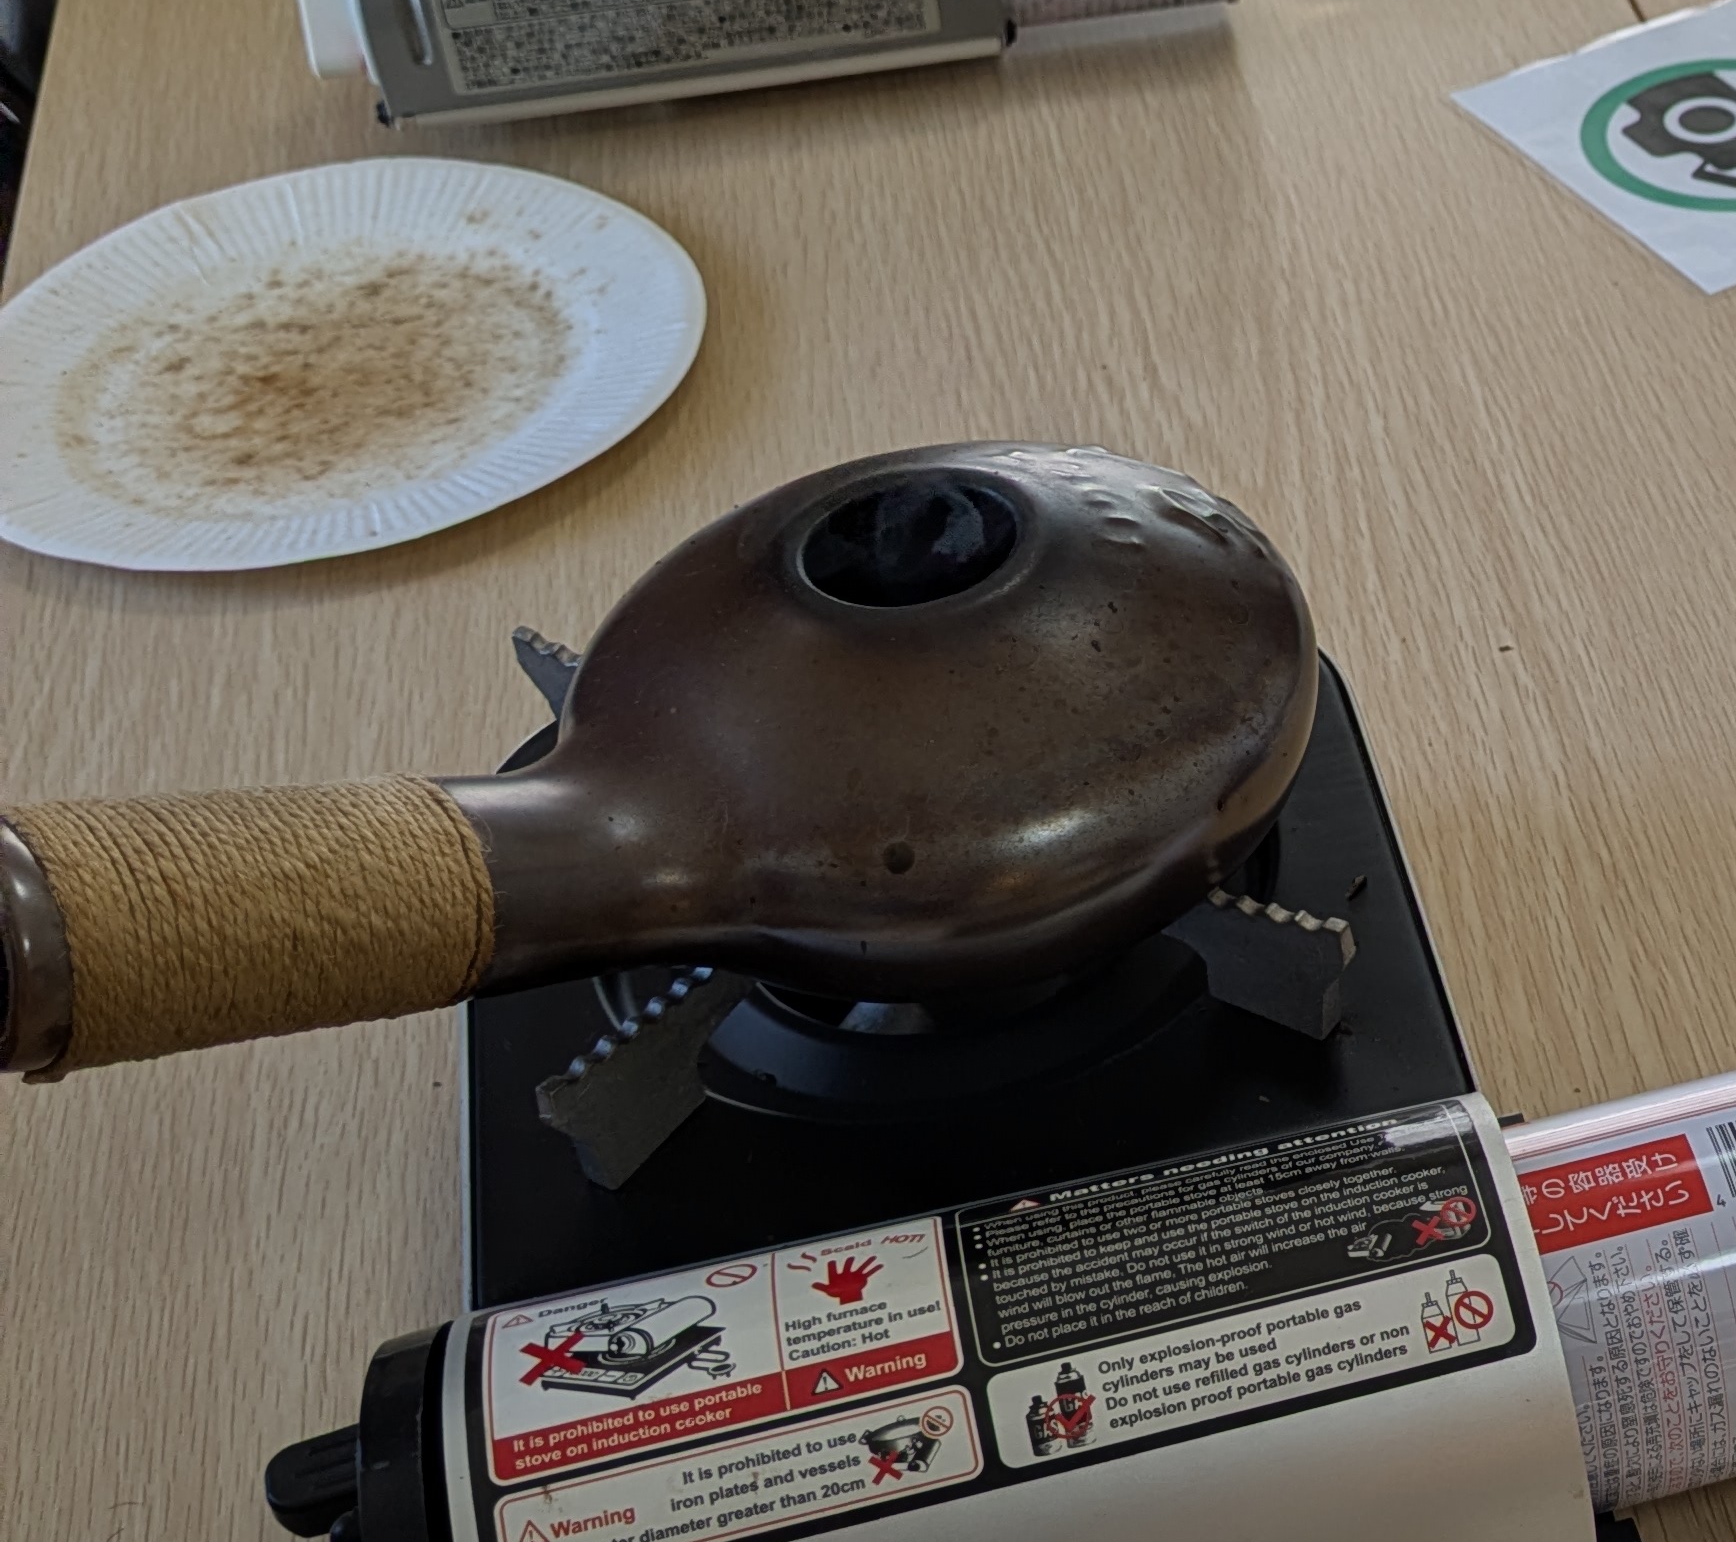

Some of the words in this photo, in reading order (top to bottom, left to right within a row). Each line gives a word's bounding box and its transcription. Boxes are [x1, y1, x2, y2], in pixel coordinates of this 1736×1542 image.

[1049, 1171, 1154, 1201] Matters
[1162, 1146, 1269, 1177] needing
[1277, 1117, 1397, 1150] attention
[1714, 1193, 1726, 1209] 4
[819, 1238, 872, 1257] Scald
[880, 1227, 926, 1250] HOT!
[995, 1283, 1048, 1304] touched
[1050, 1279, 1068, 1292] by
[1126, 1260, 1146, 1273] Do
[1148, 1254, 1170, 1267] not
[1172, 1250, 1196, 1262] use
[1198, 1246, 1207, 1256] it
[1209, 1242, 1221, 1253] in
[1222, 1232, 1264, 1251] strong
[1265, 1225, 1295, 1239] wind
[1298, 1222, 1312, 1232] or
[1314, 1215, 1335, 1228] hot
[1373, 1193, 1427, 1214] because
[1428, 1184, 1468, 1203] strong
[538, 1296, 607, 1318] Danger
[784, 1314, 821, 1335] High
[824, 1299, 887, 1323] furnace
[1000, 1311, 1059, 1335] pressure
[1061, 1306, 1073, 1318] in
[1075, 1300, 1097, 1314] the
[1154, 1274, 1206, 1296] causing
[1207, 1258, 1272, 1283] explosion.
[1004, 1332, 1025, 1346] Do
[1026, 1326, 1048, 1341] not
[1050, 1317, 1086, 1337] place
[1087, 1315, 1096, 1326] it
[1098, 1311, 1111, 1324] in
[1113, 1305, 1135, 1320] the
[1137, 1296, 1175, 1314] reach
[1176, 1292, 1191, 1305] of
[1192, 1278, 1247, 1301] children.
[785, 1314, 883, 1349] temperature
[886, 1309, 902, 1322] in
[906, 1300, 940, 1317] use!
[787, 1335, 855, 1361] Caution:
[860, 1327, 890, 1343] Hot
[1097, 1354, 1135, 1376] Only
[1138, 1322, 1264, 1366] explosion-proof
[1265, 1306, 1330, 1334] portable
[1332, 1300, 1362, 1318] gas
[846, 1351, 926, 1384] Warning
[1101, 1362, 1176, 1394] cylinders
[1178, 1355, 1213, 1375] may
[1215, 1347, 1236, 1363] be
[1238, 1336, 1277, 1357] used
[1104, 1392, 1128, 1409] Do
[1130, 1385, 1158, 1402] not
[1161, 1379, 1189, 1395] use
[1192, 1363, 1247, 1387] refilled
[1250, 1357, 1280, 1375] gas
[1281, 1336, 1355, 1367] cylinders
[1358, 1333, 1376, 1346] or
[1378, 1325, 1409, 1341] non
[1108, 1397, 1187, 1430] explosion
[1190, 1385, 1234, 1409] proof
[1235, 1368, 1302, 1398] portable
[1304, 1362, 1334, 1381] gas
[1335, 1342, 1408, 1373] cylinders
[513, 1438, 525, 1451] It
[530, 1433, 546, 1447] is
[551, 1411, 639, 1445] prohibited
[642, 1406, 660, 1421] to
[664, 1400, 693, 1416] use
[697, 1381, 762, 1410] portable
[515, 1446, 563, 1468] stove
[566, 1442, 589, 1456] on
[593, 1420, 672, 1449] induction
[682, 1469, 694, 1483] It
[697, 1464, 713, 1480] is
[717, 1442, 802, 1478] prohibited
[805, 1437, 823, 1453] to
[827, 1431, 857, 1448] use
[670, 1490, 703, 1511] iron
[707, 1477, 758, 1504] plates
[761, 1468, 793, 1488] and
[796, 1451, 861, 1479] vessels
[711, 1498, 773, 1527] greater
[776, 1488, 815, 1508] than
[818, 1475, 865, 1497] 20cm
[550, 1504, 635, 1542] Warning
